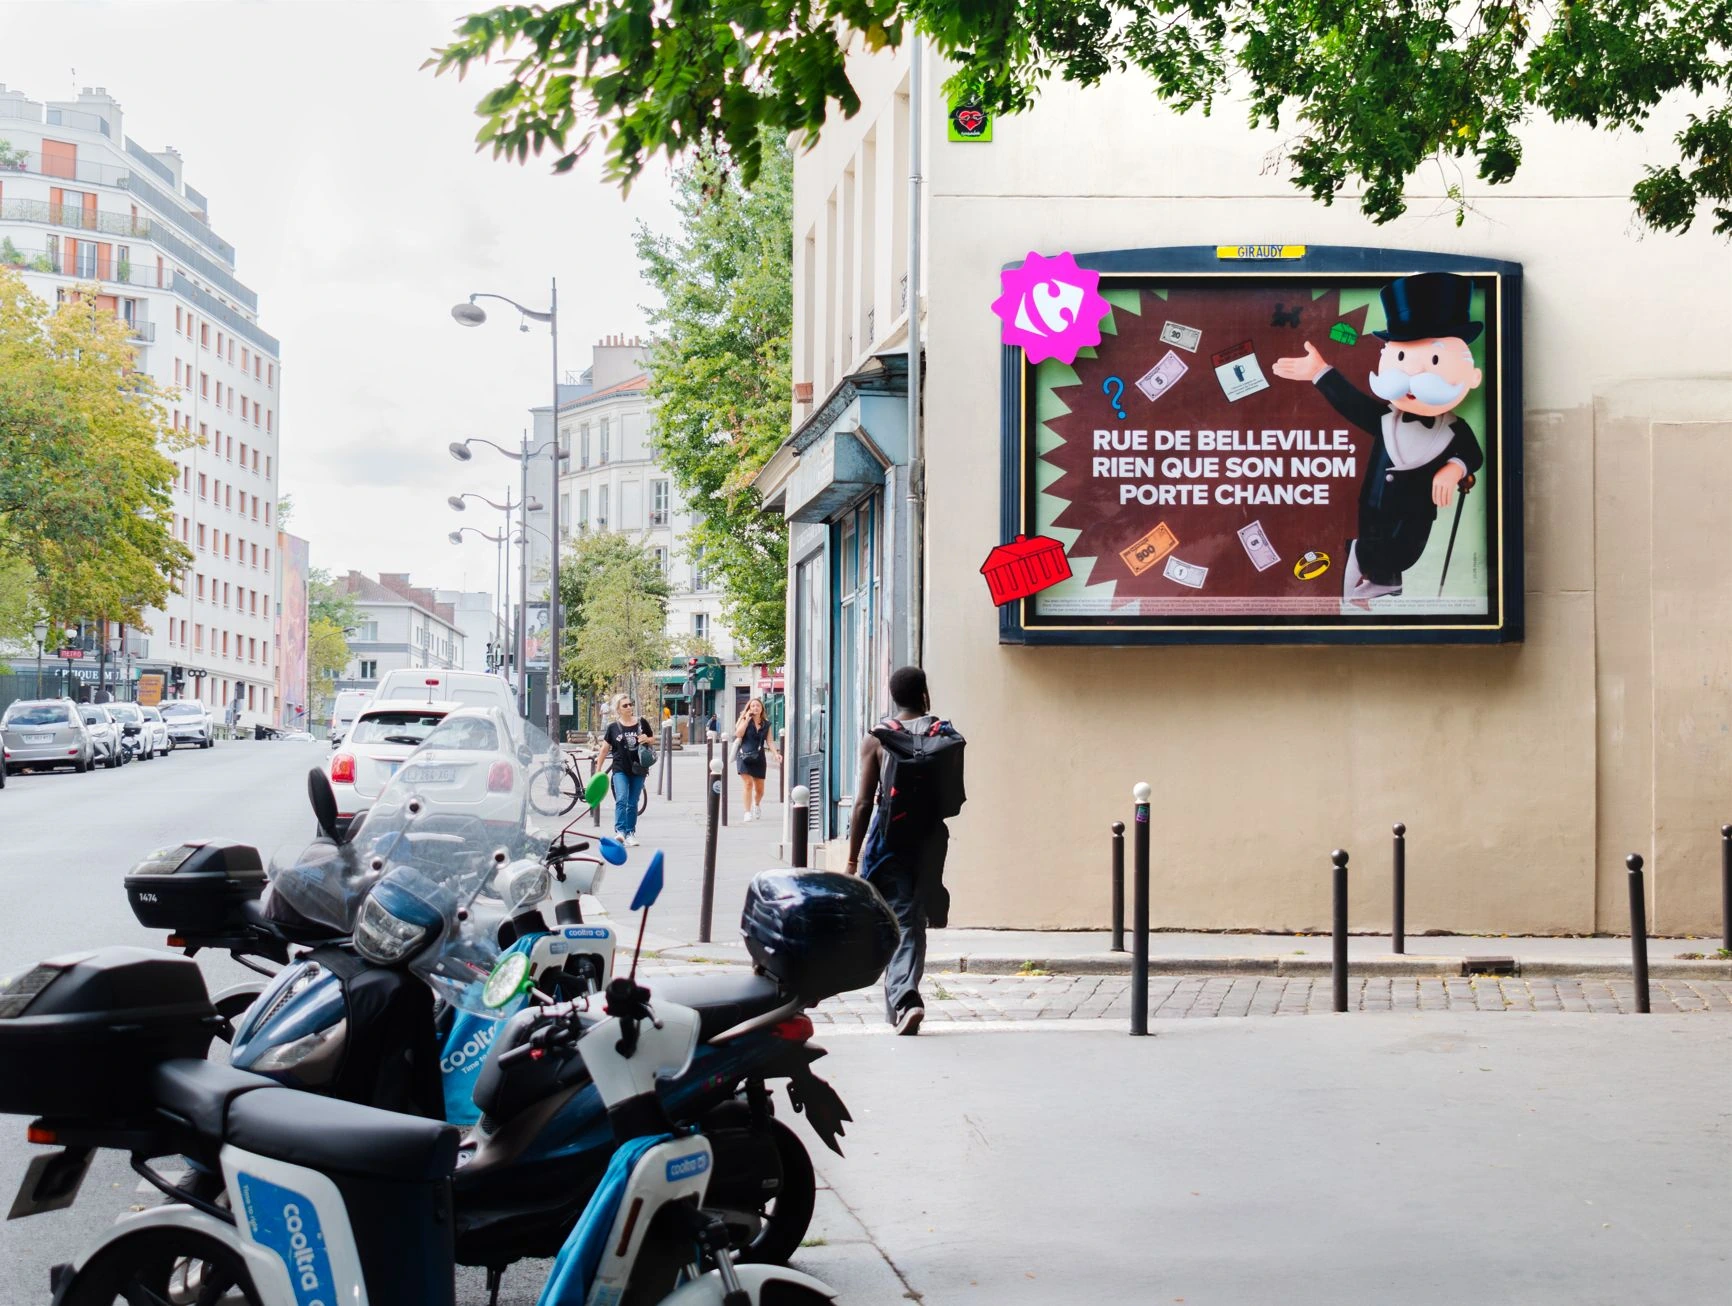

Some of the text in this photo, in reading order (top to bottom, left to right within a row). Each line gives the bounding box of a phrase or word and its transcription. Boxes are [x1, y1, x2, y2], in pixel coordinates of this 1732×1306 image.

[1237, 246, 1283, 257] GIRAUDY
[1093, 430, 1356, 453] RUE DE BELLEVILLE,
[1092, 457, 1356, 478] RIEN QUE SON NOM
[1120, 484, 1330, 505] PORTE CHANCE
[1135, 545, 1156, 562] 500
[139, 892, 158, 902] 1474
[568, 928, 594, 937] cooltra
[440, 1024, 496, 1073] cooltr
[283, 1203, 318, 1291] cooltra
